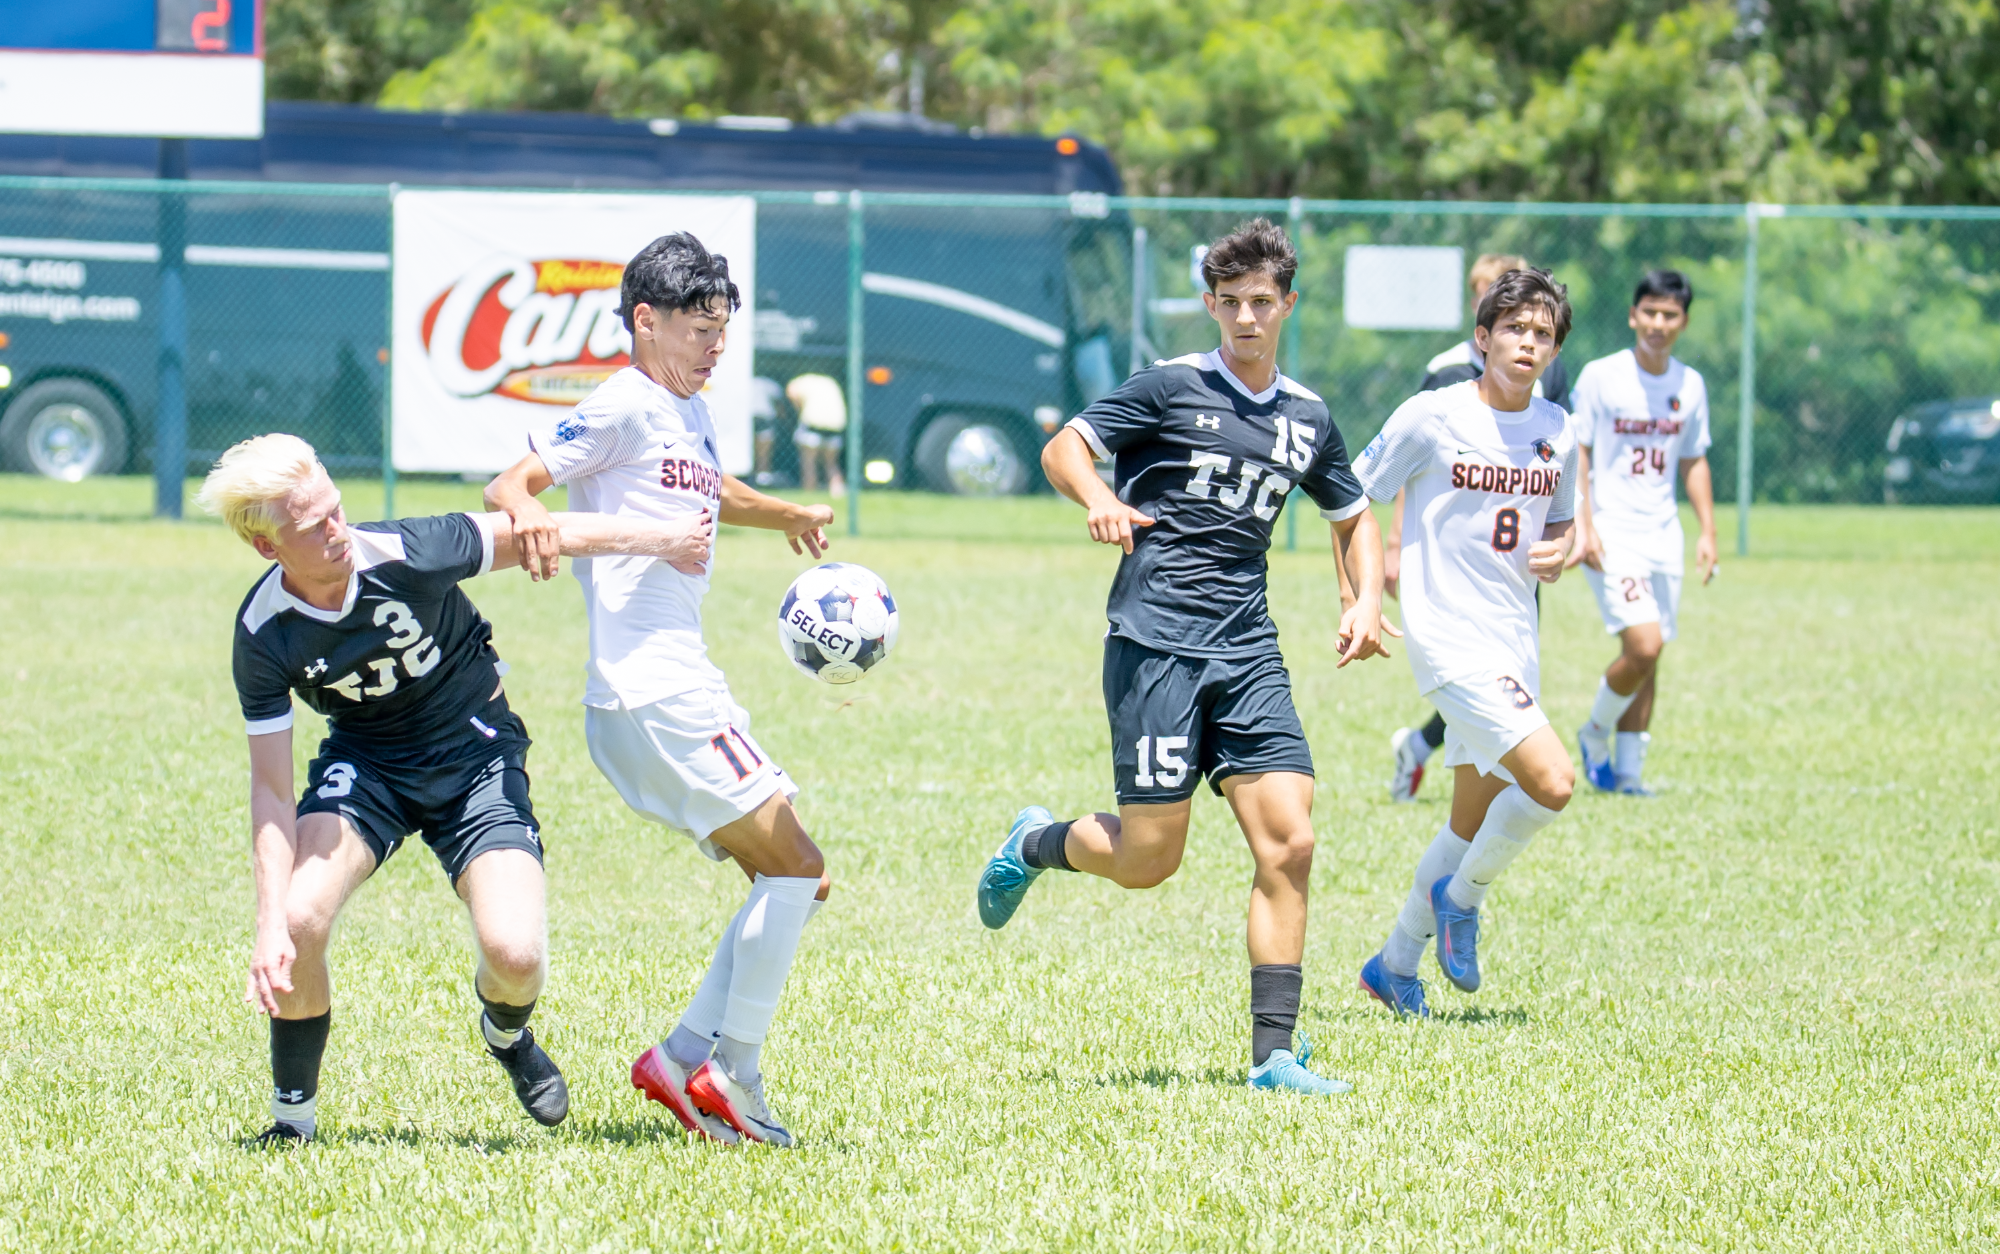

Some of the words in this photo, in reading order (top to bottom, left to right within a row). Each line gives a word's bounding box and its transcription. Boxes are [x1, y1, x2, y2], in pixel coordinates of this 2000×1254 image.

[427, 252, 634, 398] Can
[1271, 415, 1316, 473] 15
[1632, 447, 1666, 476] 24
[660, 458, 722, 502] SCORPIO
[1185, 449, 1291, 522] TJC
[1491, 507, 1521, 553] 8
[372, 600, 424, 649] 3
[791, 608, 855, 656] SELECT
[709, 722, 764, 784] 11
[1134, 734, 1189, 789] 15
[316, 762, 359, 800] 3
